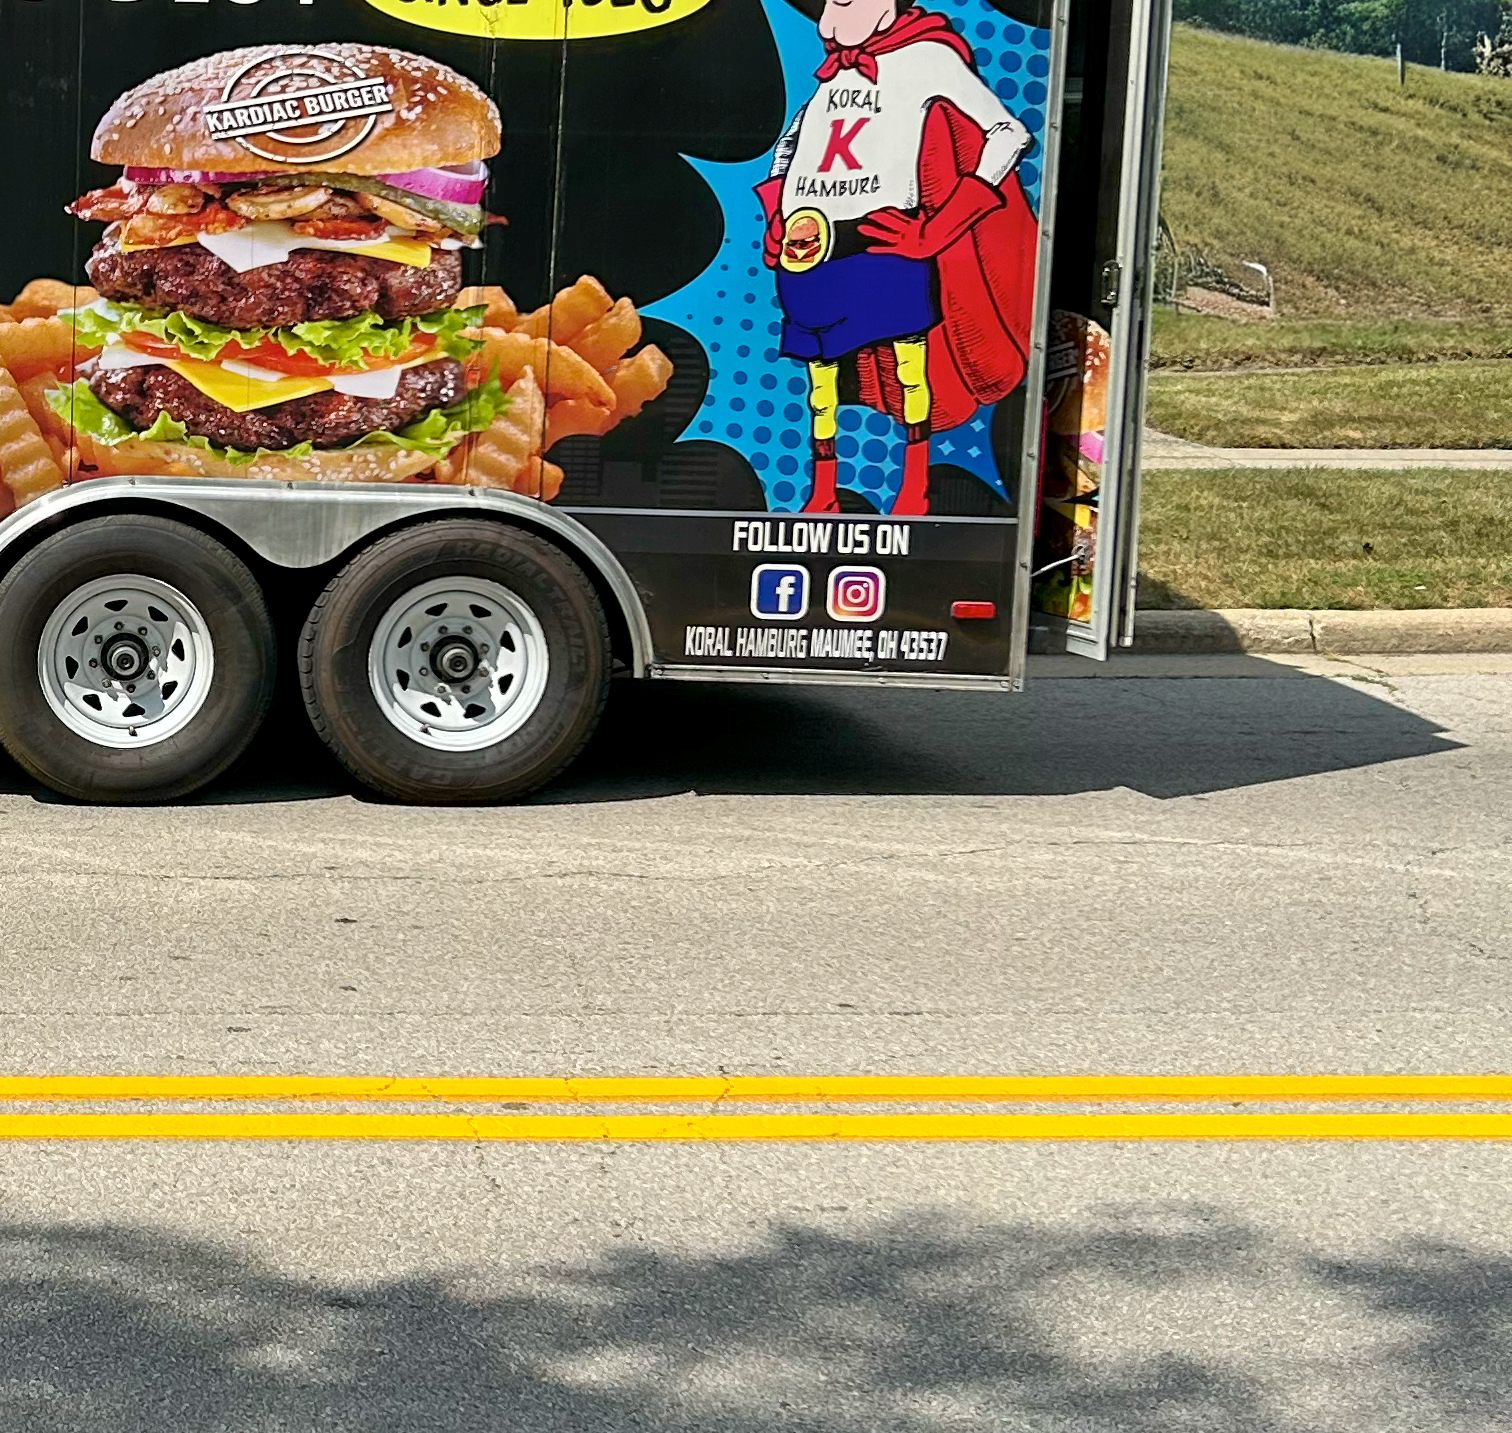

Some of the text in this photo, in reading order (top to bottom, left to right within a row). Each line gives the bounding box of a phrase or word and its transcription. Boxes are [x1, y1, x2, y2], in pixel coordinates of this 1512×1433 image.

[207, 85, 389, 131] KARDIAC BURGER
[826, 89, 881, 113] KORAL
[817, 117, 870, 172] K
[795, 175, 880, 197] HAMBURG
[733, 521, 909, 555] FOLLOW US ON
[685, 626, 733, 656] KORAL
[736, 628, 808, 658] HAMBURG
[878, 631, 898, 659] OH
[900, 631, 948, 660] 43537
